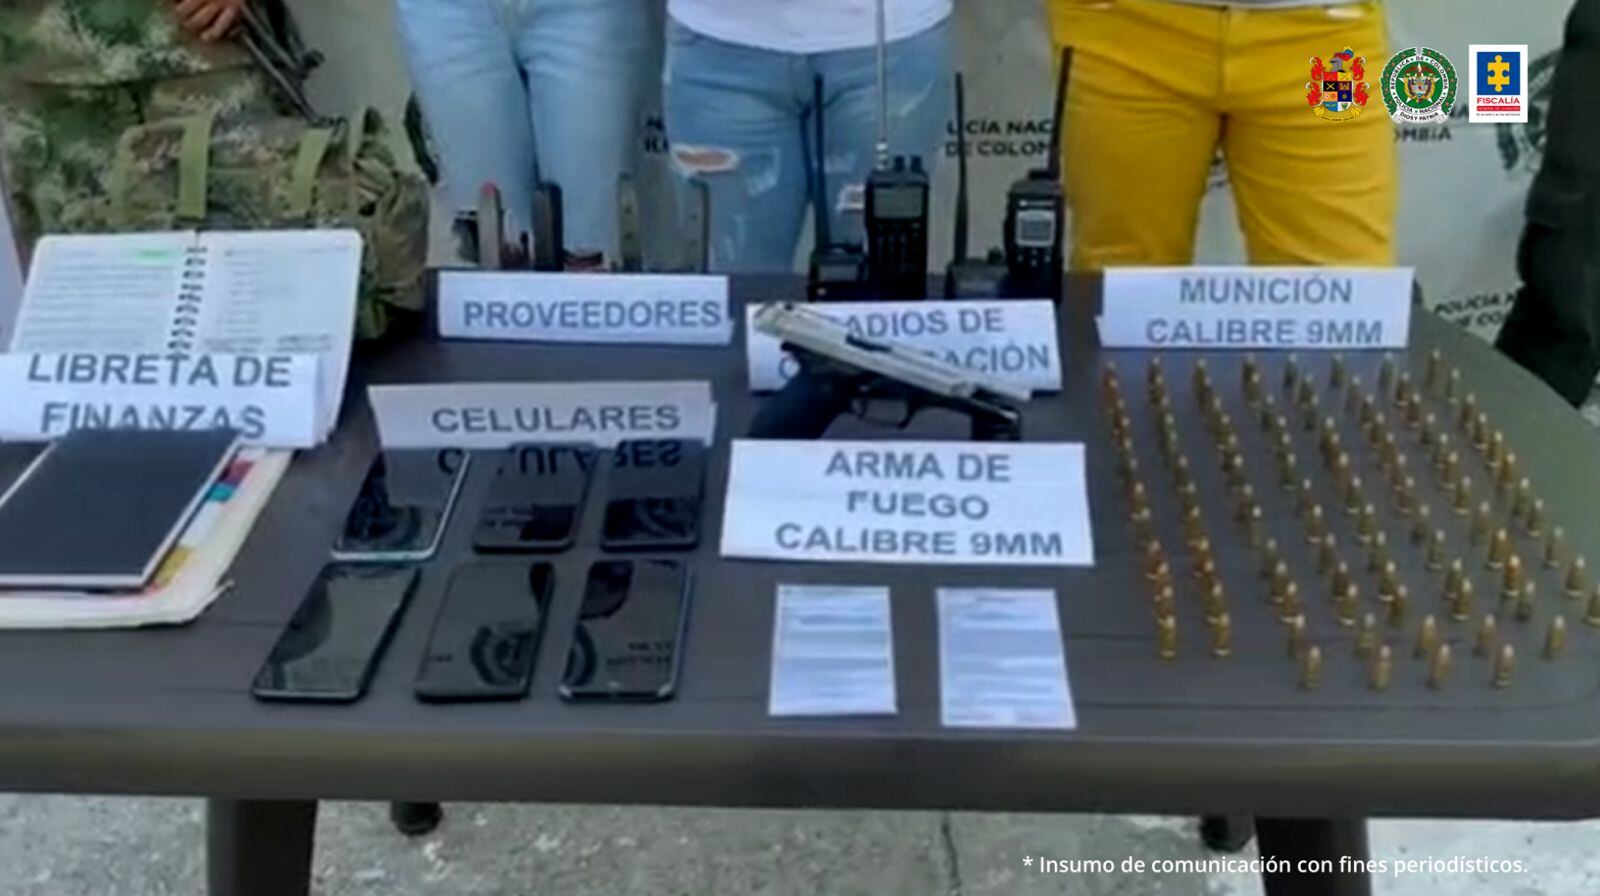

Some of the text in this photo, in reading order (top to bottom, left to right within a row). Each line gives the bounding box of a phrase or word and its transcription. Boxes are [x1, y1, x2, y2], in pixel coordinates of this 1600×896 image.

[1179, 275, 1353, 305] MUNICIÓN
[463, 300, 721, 329] PROVEEDORES
[844, 307, 1005, 339] ADIOS DE
[1145, 318, 1383, 345] CALIBRE 9MM
[27, 352, 292, 387] LIBRETA DE
[41, 402, 267, 440] FINANZAS
[431, 404, 680, 433] CELULARES
[824, 450, 1011, 482] ARMA DE
[847, 490, 989, 521] FUEGO
[774, 523, 1063, 556] CALIBRE 9MM
